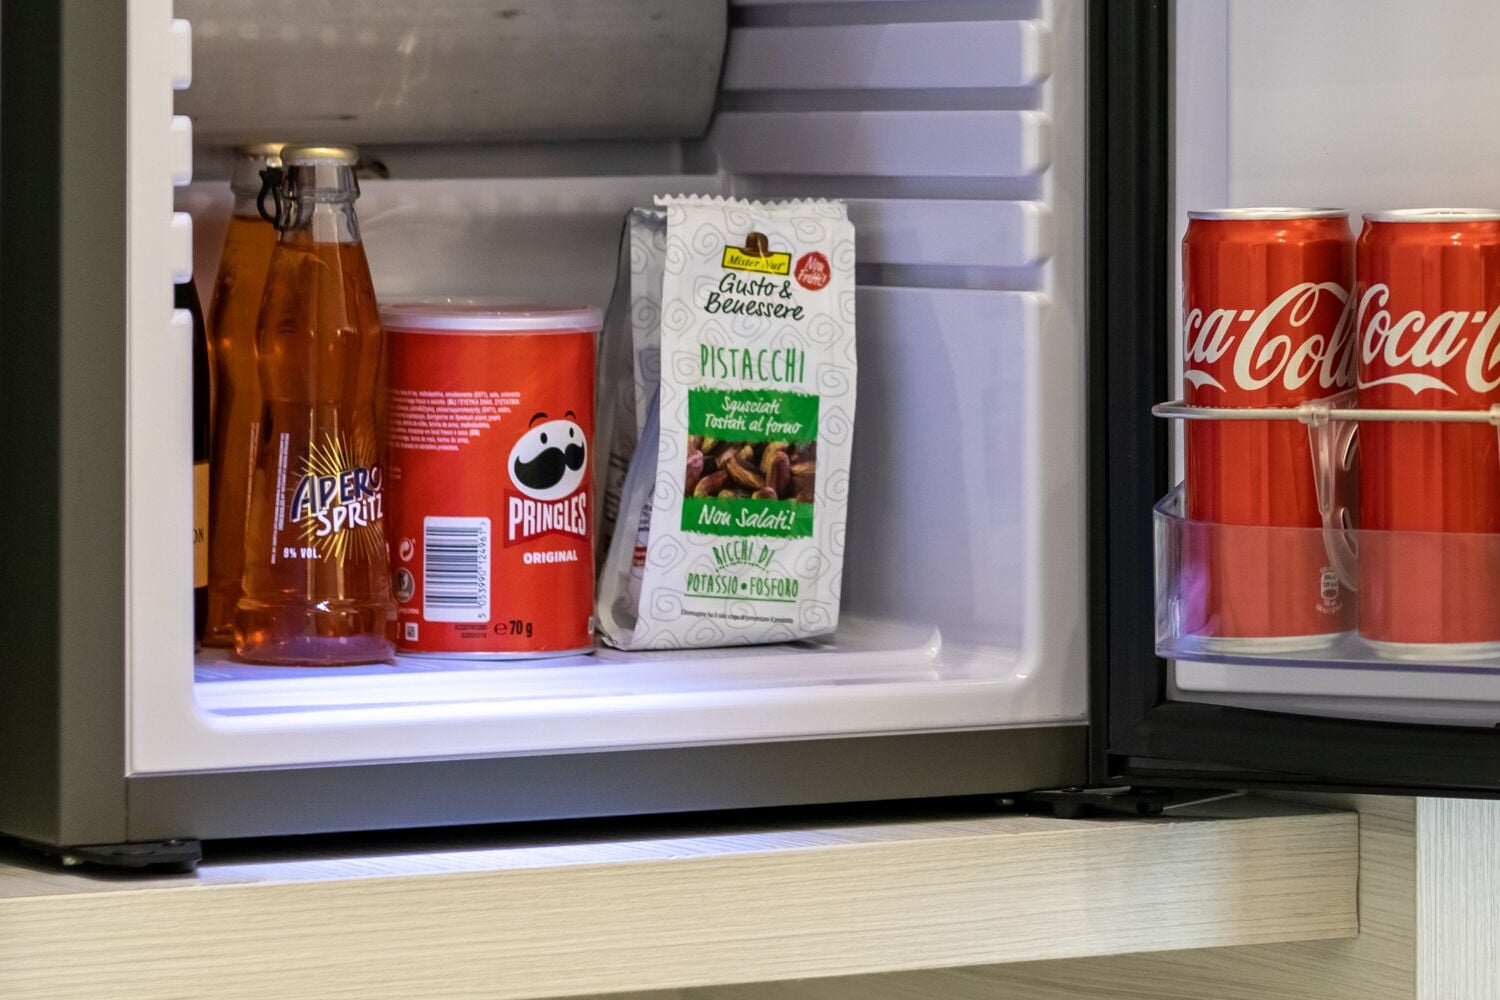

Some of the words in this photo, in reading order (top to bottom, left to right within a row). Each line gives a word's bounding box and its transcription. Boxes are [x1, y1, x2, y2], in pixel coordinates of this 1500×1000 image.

[728, 254, 760, 268] Mister
[719, 272, 778, 297] Gusto
[779, 280, 792, 299] &
[704, 291, 805, 322] Benessere
[701, 343, 805, 384] PISTACCHI
[721, 395, 783, 419] Sgusciati
[704, 413, 747, 431] Tostati
[749, 415, 763, 432] al
[508, 492, 587, 541] PRINGLES
[698, 503, 731, 526] Non
[735, 506, 796, 530] Salati!
[283, 547, 297, 559] 9%
[301, 547, 322, 559] VOL.
[523, 549, 578, 565] ORIGINAL
[712, 539, 755, 567] RICCHI
[758, 544, 776, 568] DI
[686, 572, 738, 595] POTASSIO
[750, 576, 799, 598] FOSFORO
[509, 620, 523, 635] 70
[525, 622, 533, 638] g
